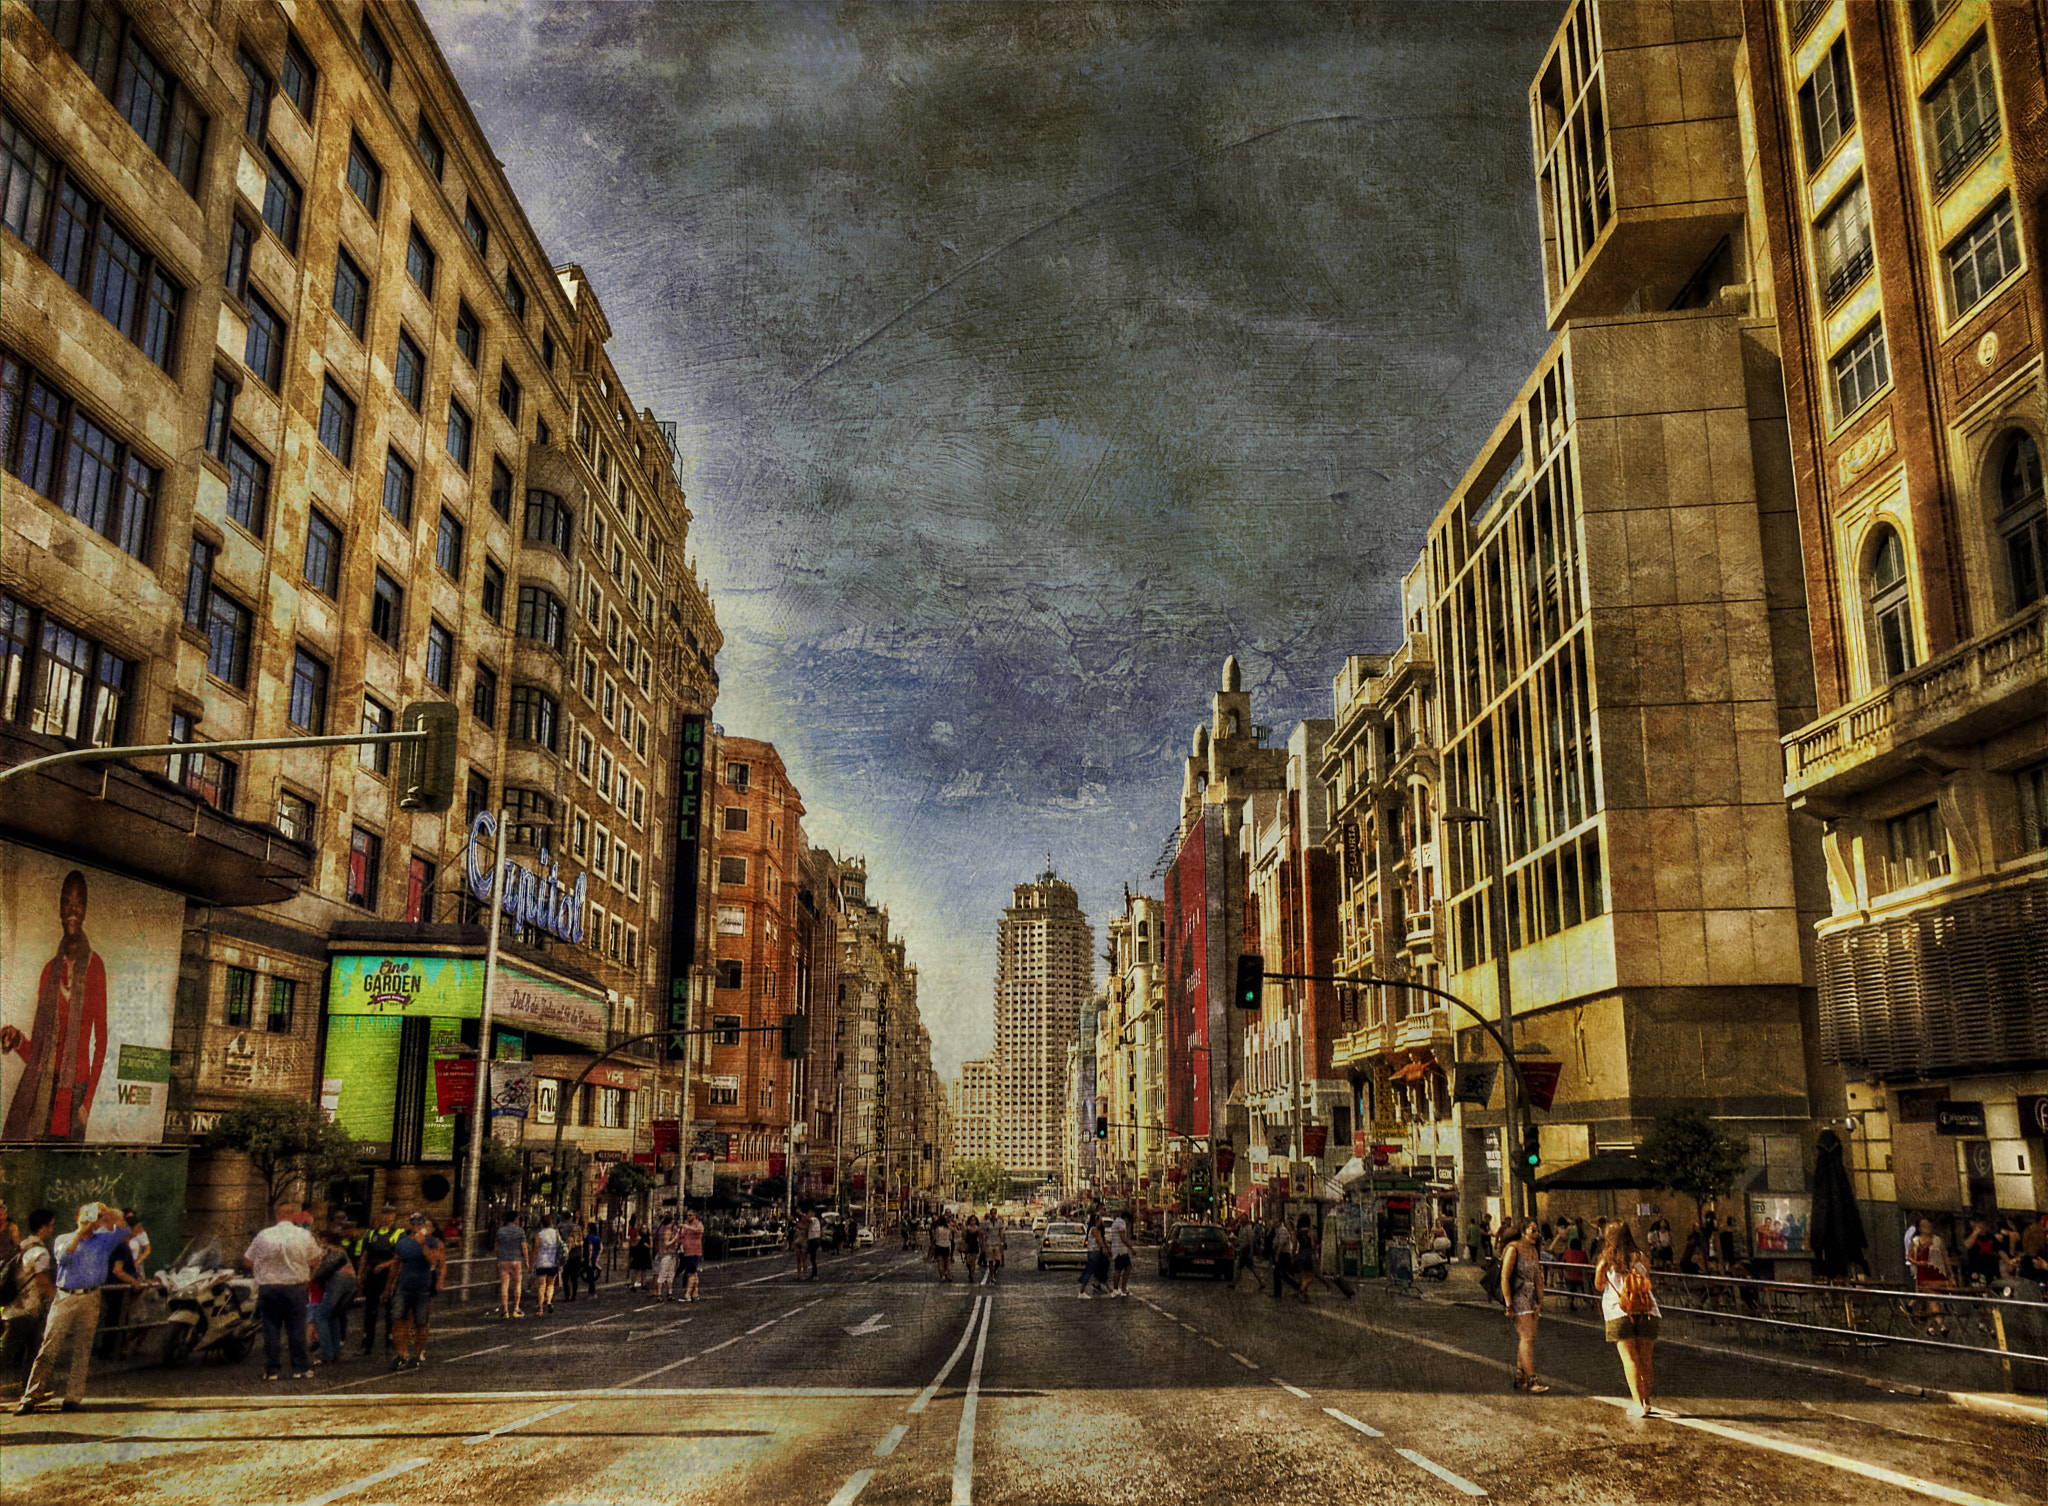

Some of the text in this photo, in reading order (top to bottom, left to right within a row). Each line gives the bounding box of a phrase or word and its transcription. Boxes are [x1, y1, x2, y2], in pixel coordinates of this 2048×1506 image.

[668, 722, 702, 1050] HOTEL REX
[379, 959, 410, 975] Cine
[363, 974, 422, 993] GARDEN
[605, 1068, 624, 1084] VIPS
[875, 991, 887, 1150] HOTEL EMPERADOR
[1438, 1168, 1453, 1180] GEOX
